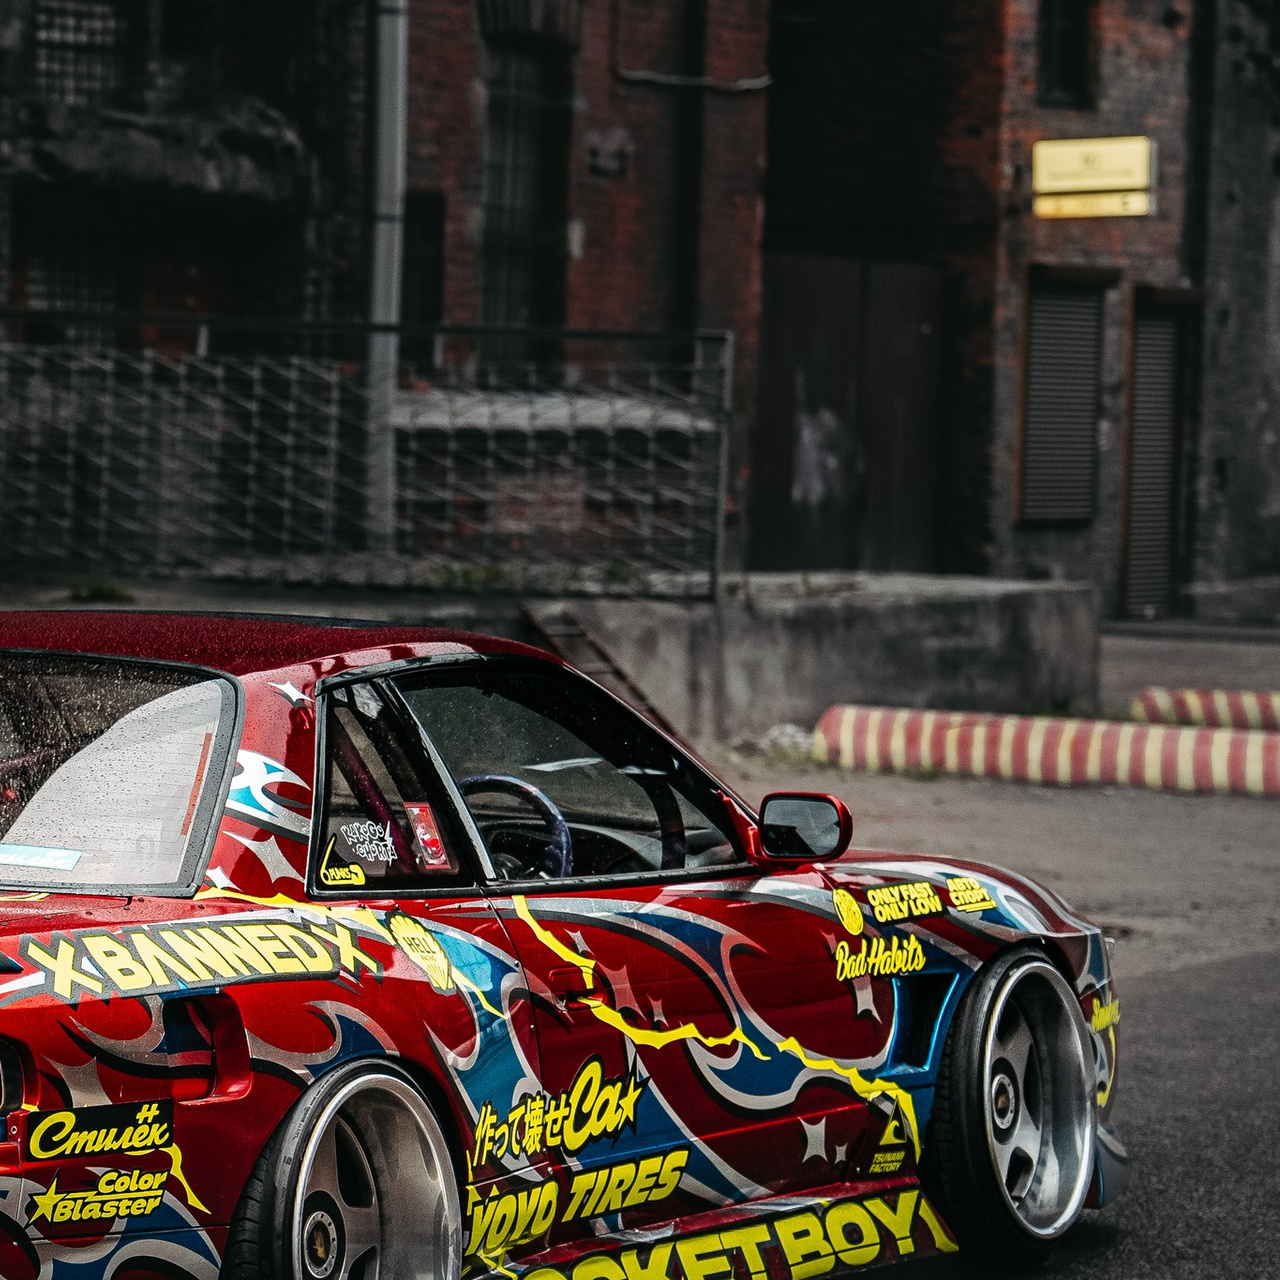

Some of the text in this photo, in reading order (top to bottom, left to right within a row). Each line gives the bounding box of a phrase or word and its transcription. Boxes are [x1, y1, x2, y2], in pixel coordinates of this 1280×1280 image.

[867, 882, 934, 906] ONLY FAST
[873, 895, 942, 922] ONLY LOW
[402, 937, 436, 954] HELL
[836, 934, 926, 981] Bad Habits
[98, 1170, 168, 1194] Color
[561, 1150, 688, 1222] TIRES
[53, 1196, 161, 1222] Blaster
